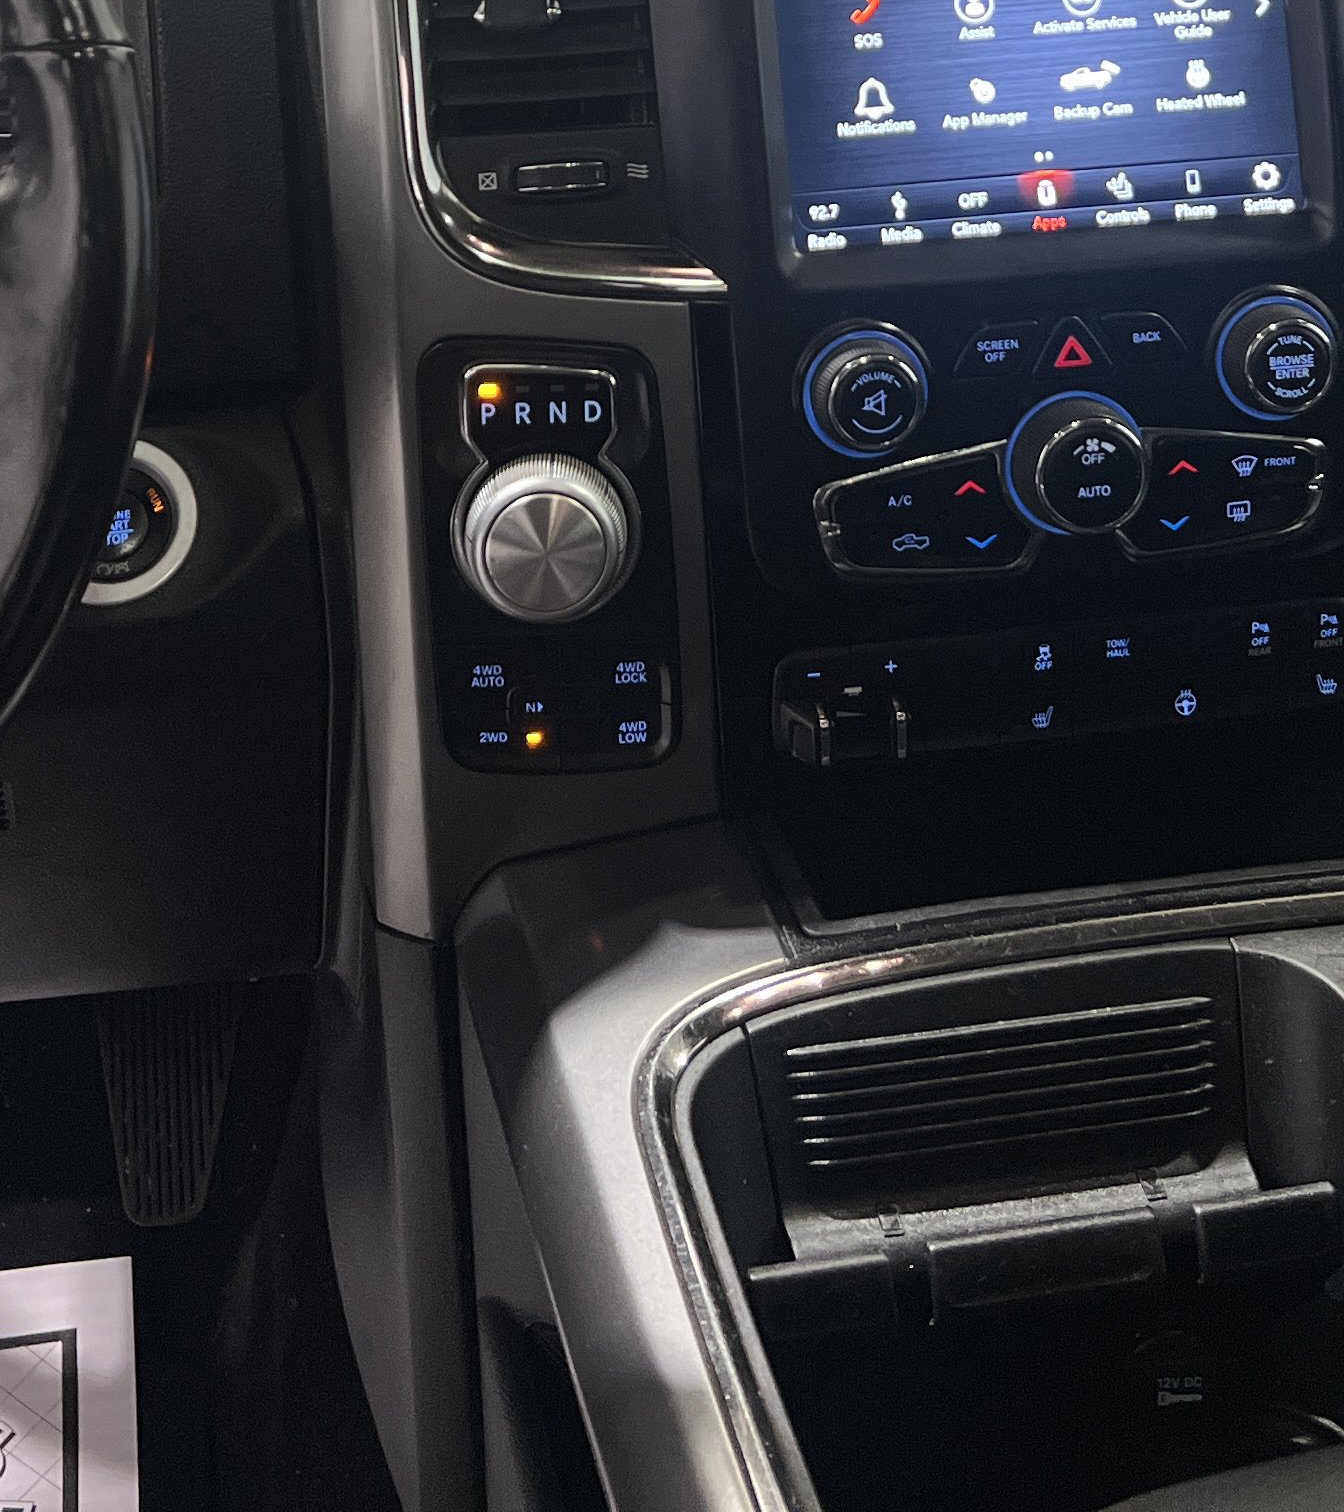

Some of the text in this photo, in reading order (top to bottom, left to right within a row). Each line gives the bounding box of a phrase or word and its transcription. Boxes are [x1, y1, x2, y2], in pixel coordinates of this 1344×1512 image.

[1153, 8, 1232, 26] Vehicle User
[1032, 16, 1138, 35] Activate Services
[1173, 24, 1214, 39] Guide
[958, 25, 996, 41] Assist
[853, 32, 885, 49] SOS
[1155, 90, 1247, 113] Heated Wheel
[1053, 101, 1134, 120] Backup Cam
[942, 110, 1028, 130] App Manager
[836, 118, 917, 138] Notifications
[957, 191, 989, 210] OFF
[1242, 196, 1296, 216] Settings
[808, 203, 841, 222] 92.7
[1095, 206, 1151, 228] Controls
[1174, 202, 1218, 221] Phone
[951, 219, 1002, 239] Climate
[1032, 215, 1067, 232] Apps
[807, 231, 847, 251] Radio
[880, 226, 923, 245] Media
[1132, 331, 1161, 344] BACK
[1277, 334, 1303, 345] TUNE
[976, 338, 1019, 352] SCREEN
[984, 351, 1007, 363] OFF
[1269, 353, 1314, 366] BROWSE
[856, 371, 896, 387] VOLUME
[1276, 368, 1310, 380] ENTER
[1275, 386, 1309, 398] SCROLL
[481, 403, 495, 425] P
[515, 402, 531, 424] R
[549, 402, 566, 423] N
[584, 400, 601, 422] D
[1081, 453, 1105, 465] OFF
[1264, 456, 1297, 467] FRONT
[1077, 485, 1112, 499] AUTO
[887, 494, 912, 507] A/C
[1320, 628, 1338, 638] OFF
[1106, 638, 1130, 649] TOW/
[1251, 636, 1270, 647] OFF
[1106, 648, 1130, 658] HAUL
[473, 664, 502, 676] 4WD
[616, 661, 645, 672] 4WD
[1034, 661, 1053, 671] OFF
[471, 676, 504, 687] AUTO
[615, 672, 647, 684] LOCK
[619, 720, 647, 732] 4WD
[480, 732, 508, 743] 2WD
[618, 732, 647, 744] LOW
[1158, 1376, 1202, 1388] 12V DC
